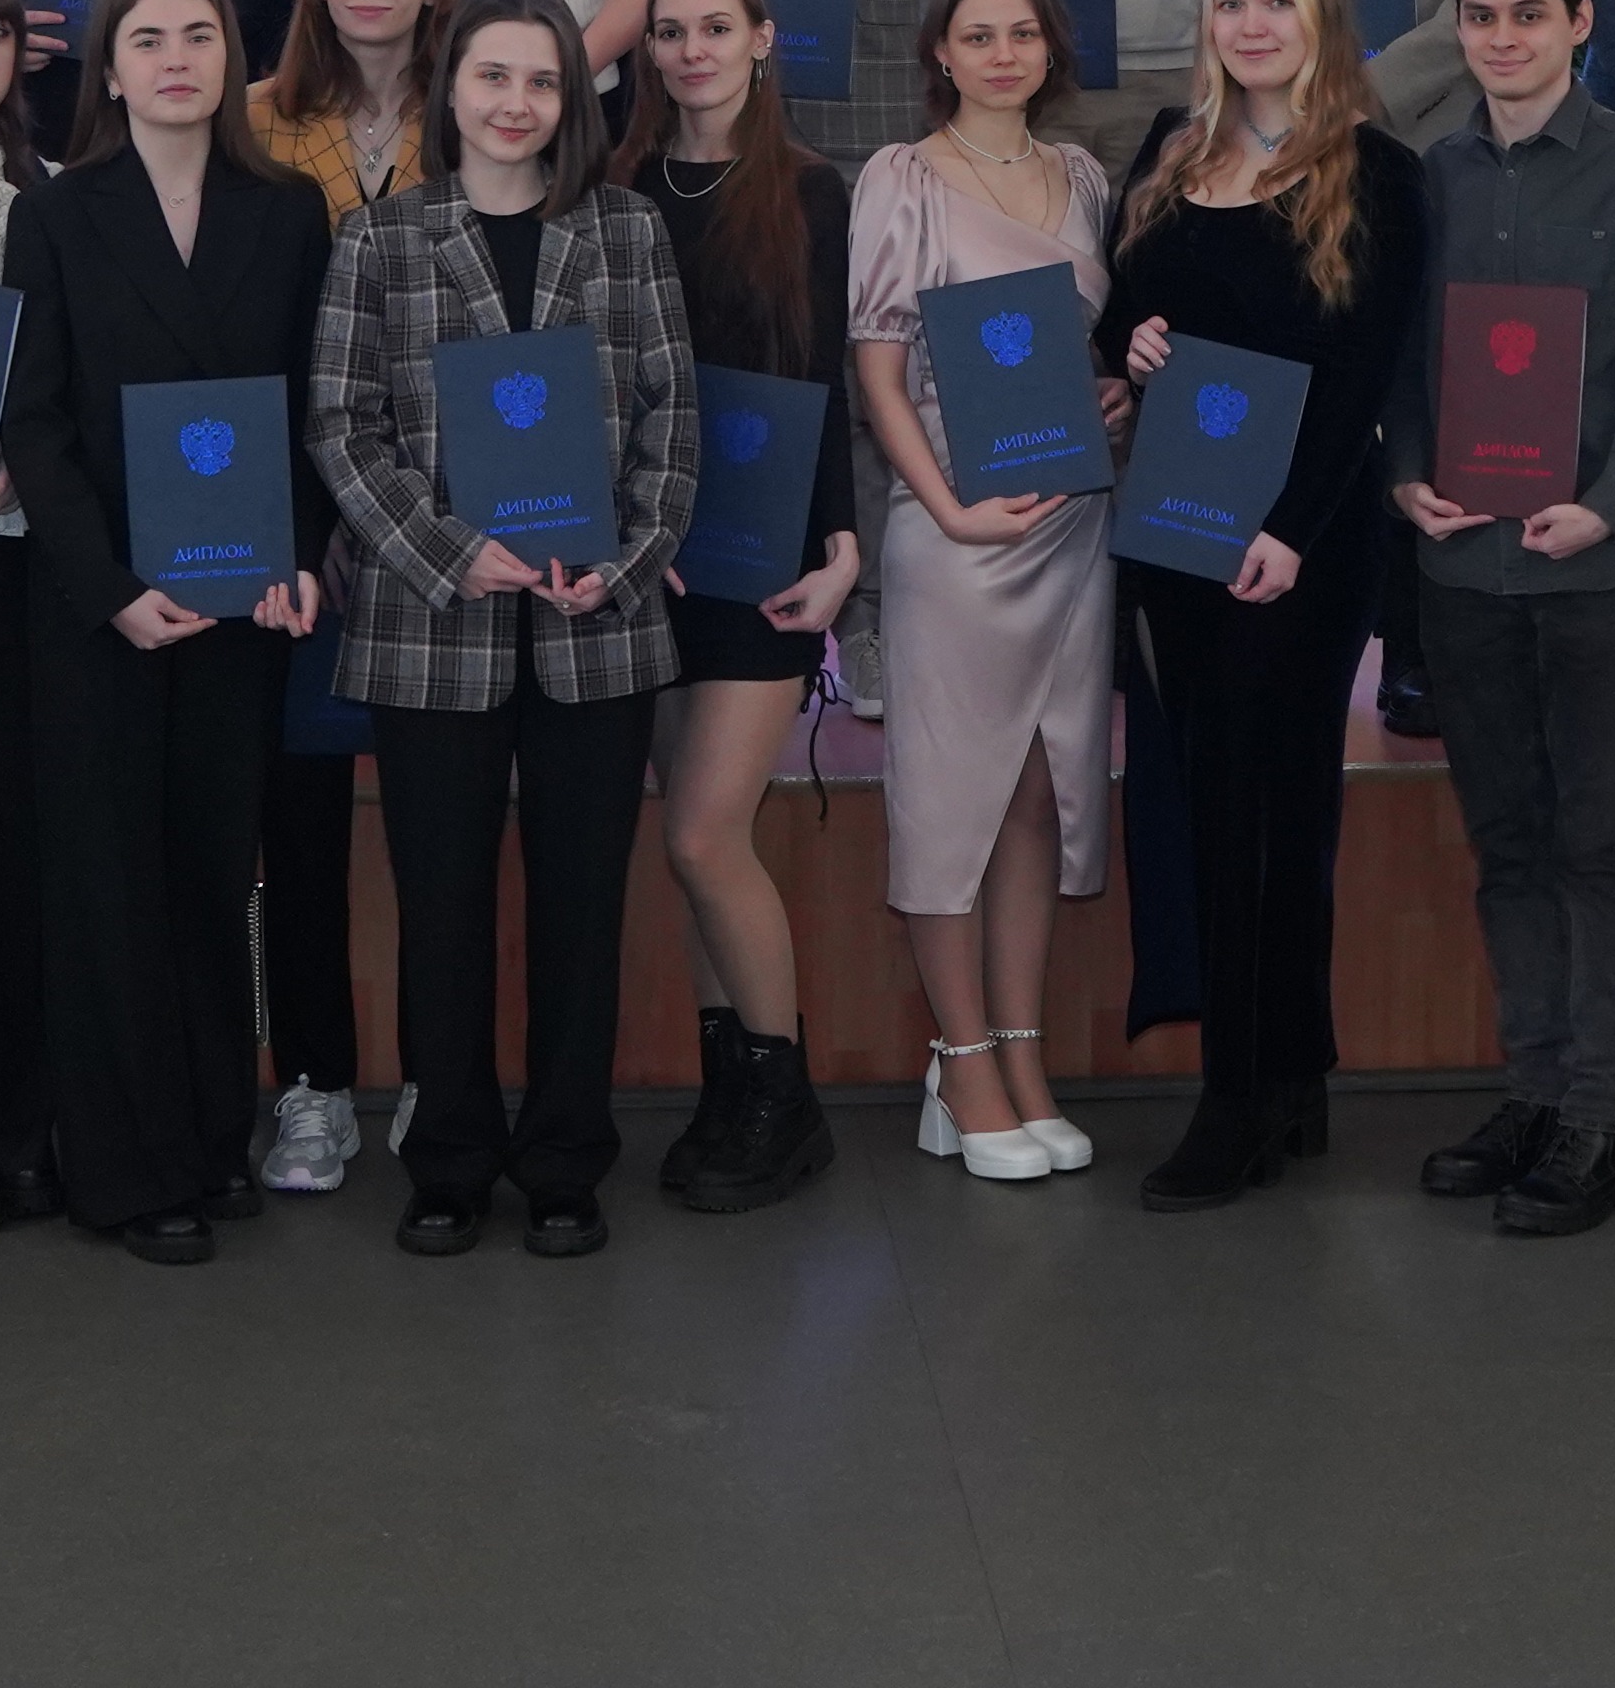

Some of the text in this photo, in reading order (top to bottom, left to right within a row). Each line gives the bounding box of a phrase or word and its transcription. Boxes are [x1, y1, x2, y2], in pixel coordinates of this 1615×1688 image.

[993, 426, 1068, 454] ДИПЛОМ
[1473, 443, 1541, 458] ДИПЛОМ
[494, 494, 573, 518] ДИПЛОМ
[1159, 496, 1235, 526] ДИПЛОМ
[174, 544, 254, 563] ДИПЛОМ
